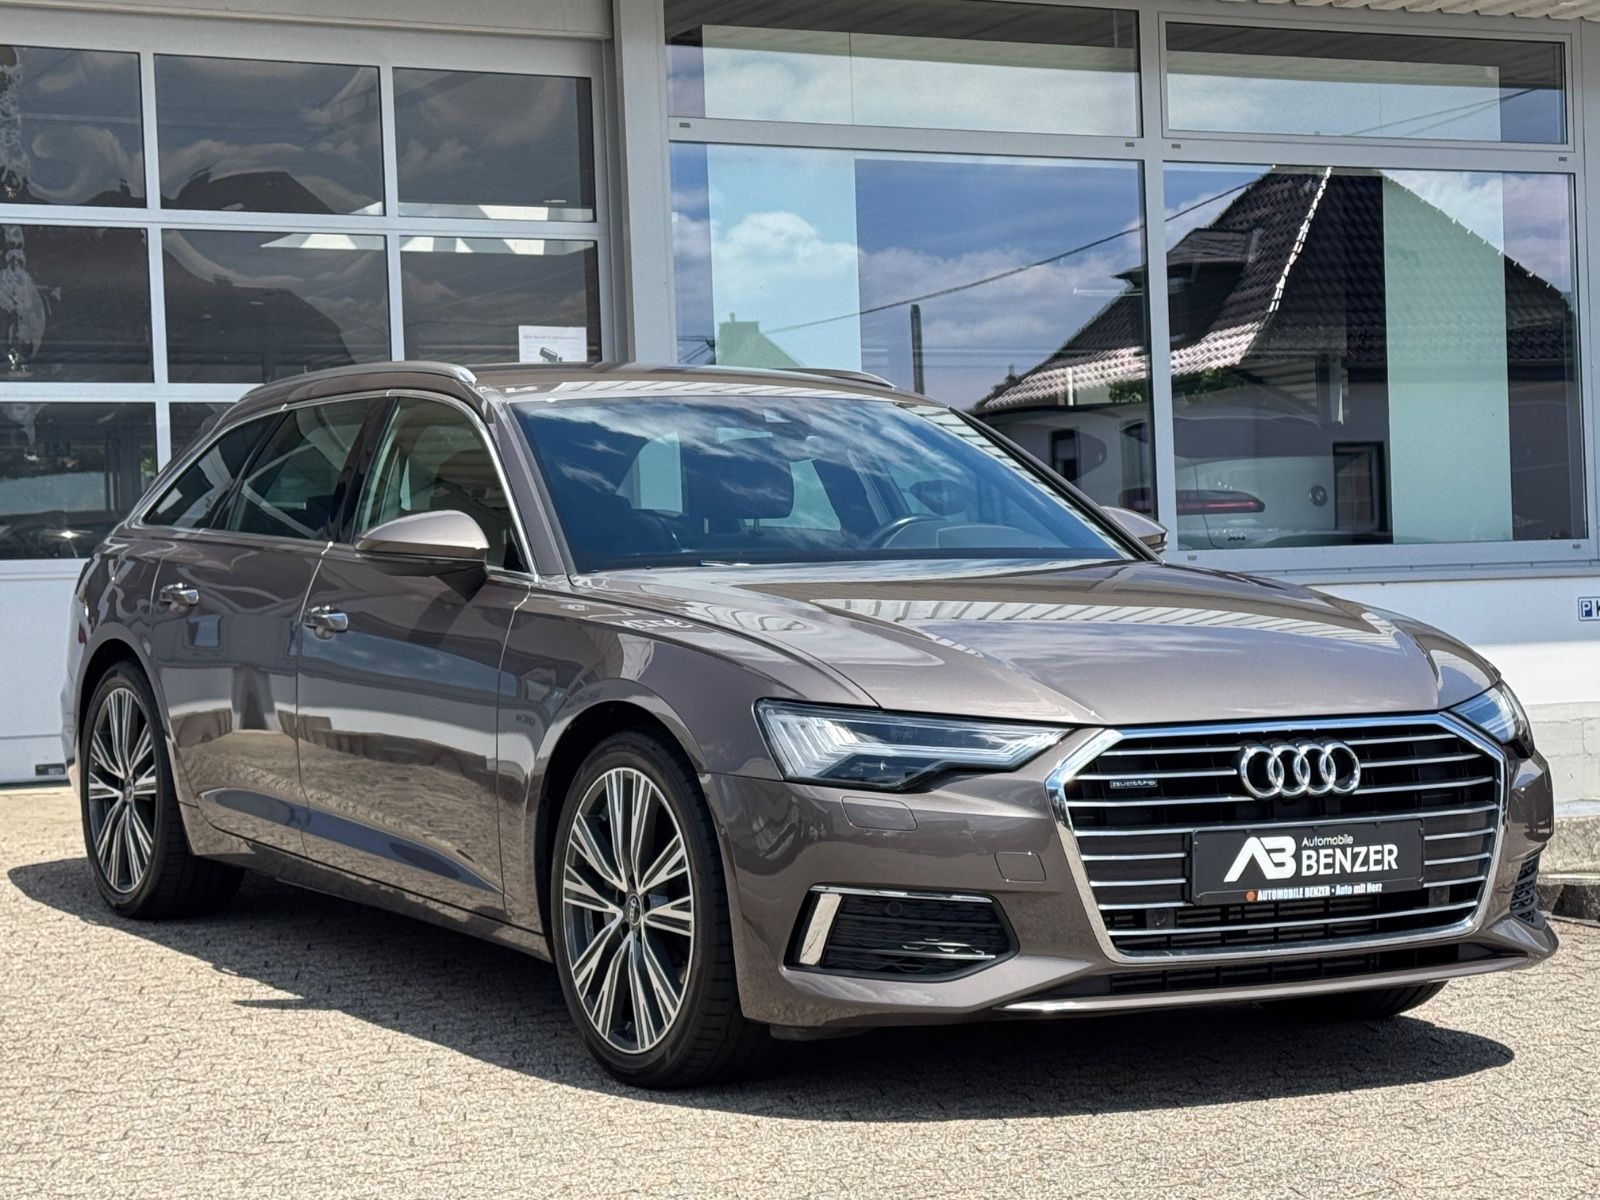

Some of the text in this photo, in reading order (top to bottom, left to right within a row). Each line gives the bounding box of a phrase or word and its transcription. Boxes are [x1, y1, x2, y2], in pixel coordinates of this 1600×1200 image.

[1582, 601, 1592, 617] P
[1301, 834, 1354, 847] Automobile
[1301, 844, 1399, 877] BENZER
[1257, 886, 1304, 901] AUTOMOBILE
[1304, 885, 1331, 898] BENZER
[1335, 884, 1353, 896] Auto
[1366, 882, 1383, 893] Herz
